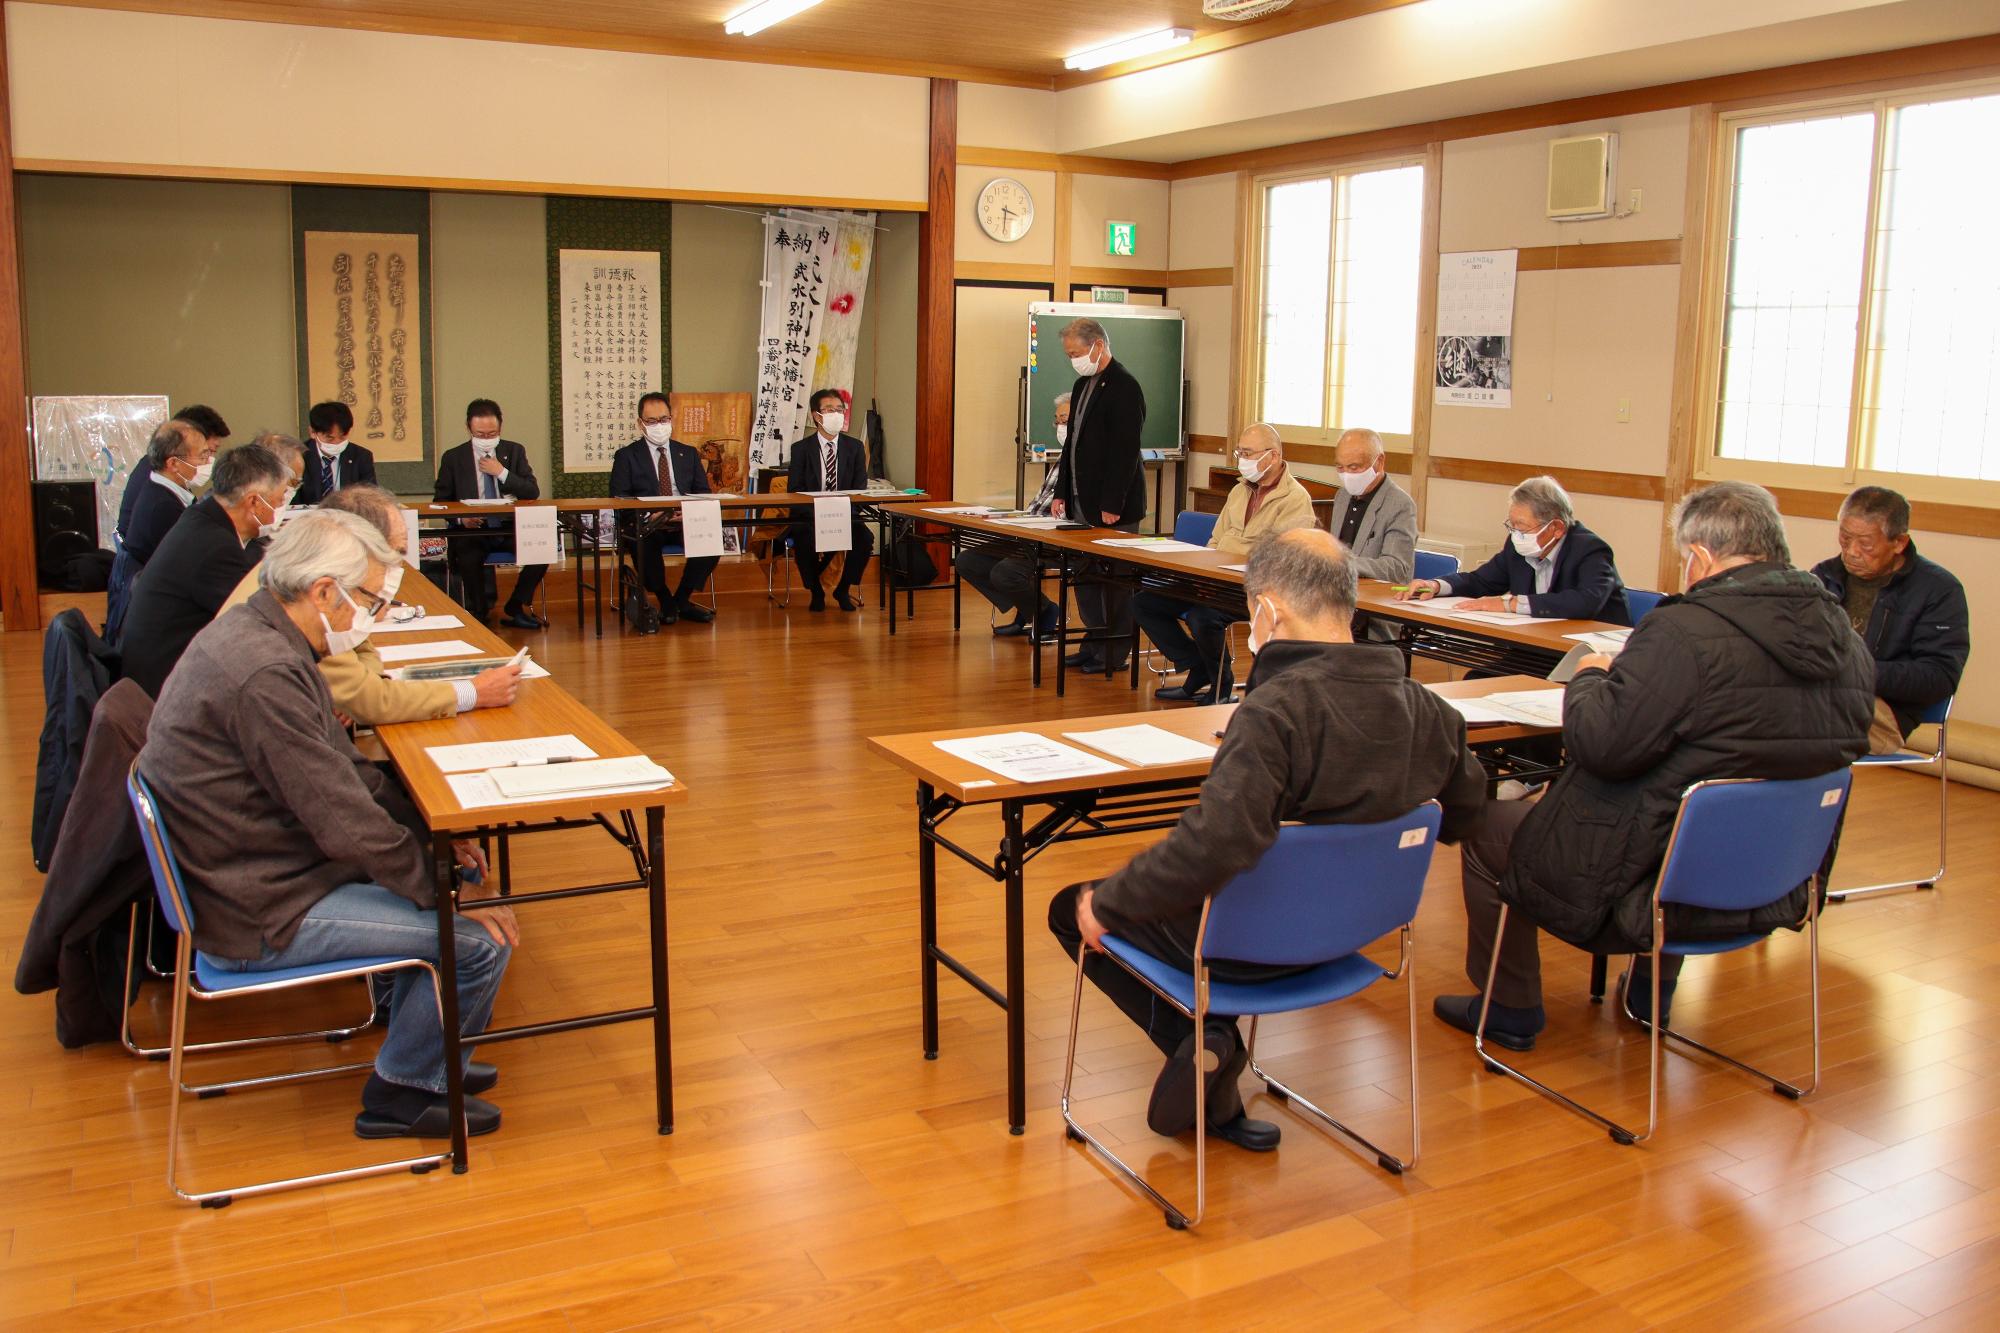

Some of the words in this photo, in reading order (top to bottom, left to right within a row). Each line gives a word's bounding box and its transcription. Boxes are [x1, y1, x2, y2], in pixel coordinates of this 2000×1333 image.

[774, 227, 812, 254] 奉納
[781, 262, 809, 402] 武水別神社八幡宮
